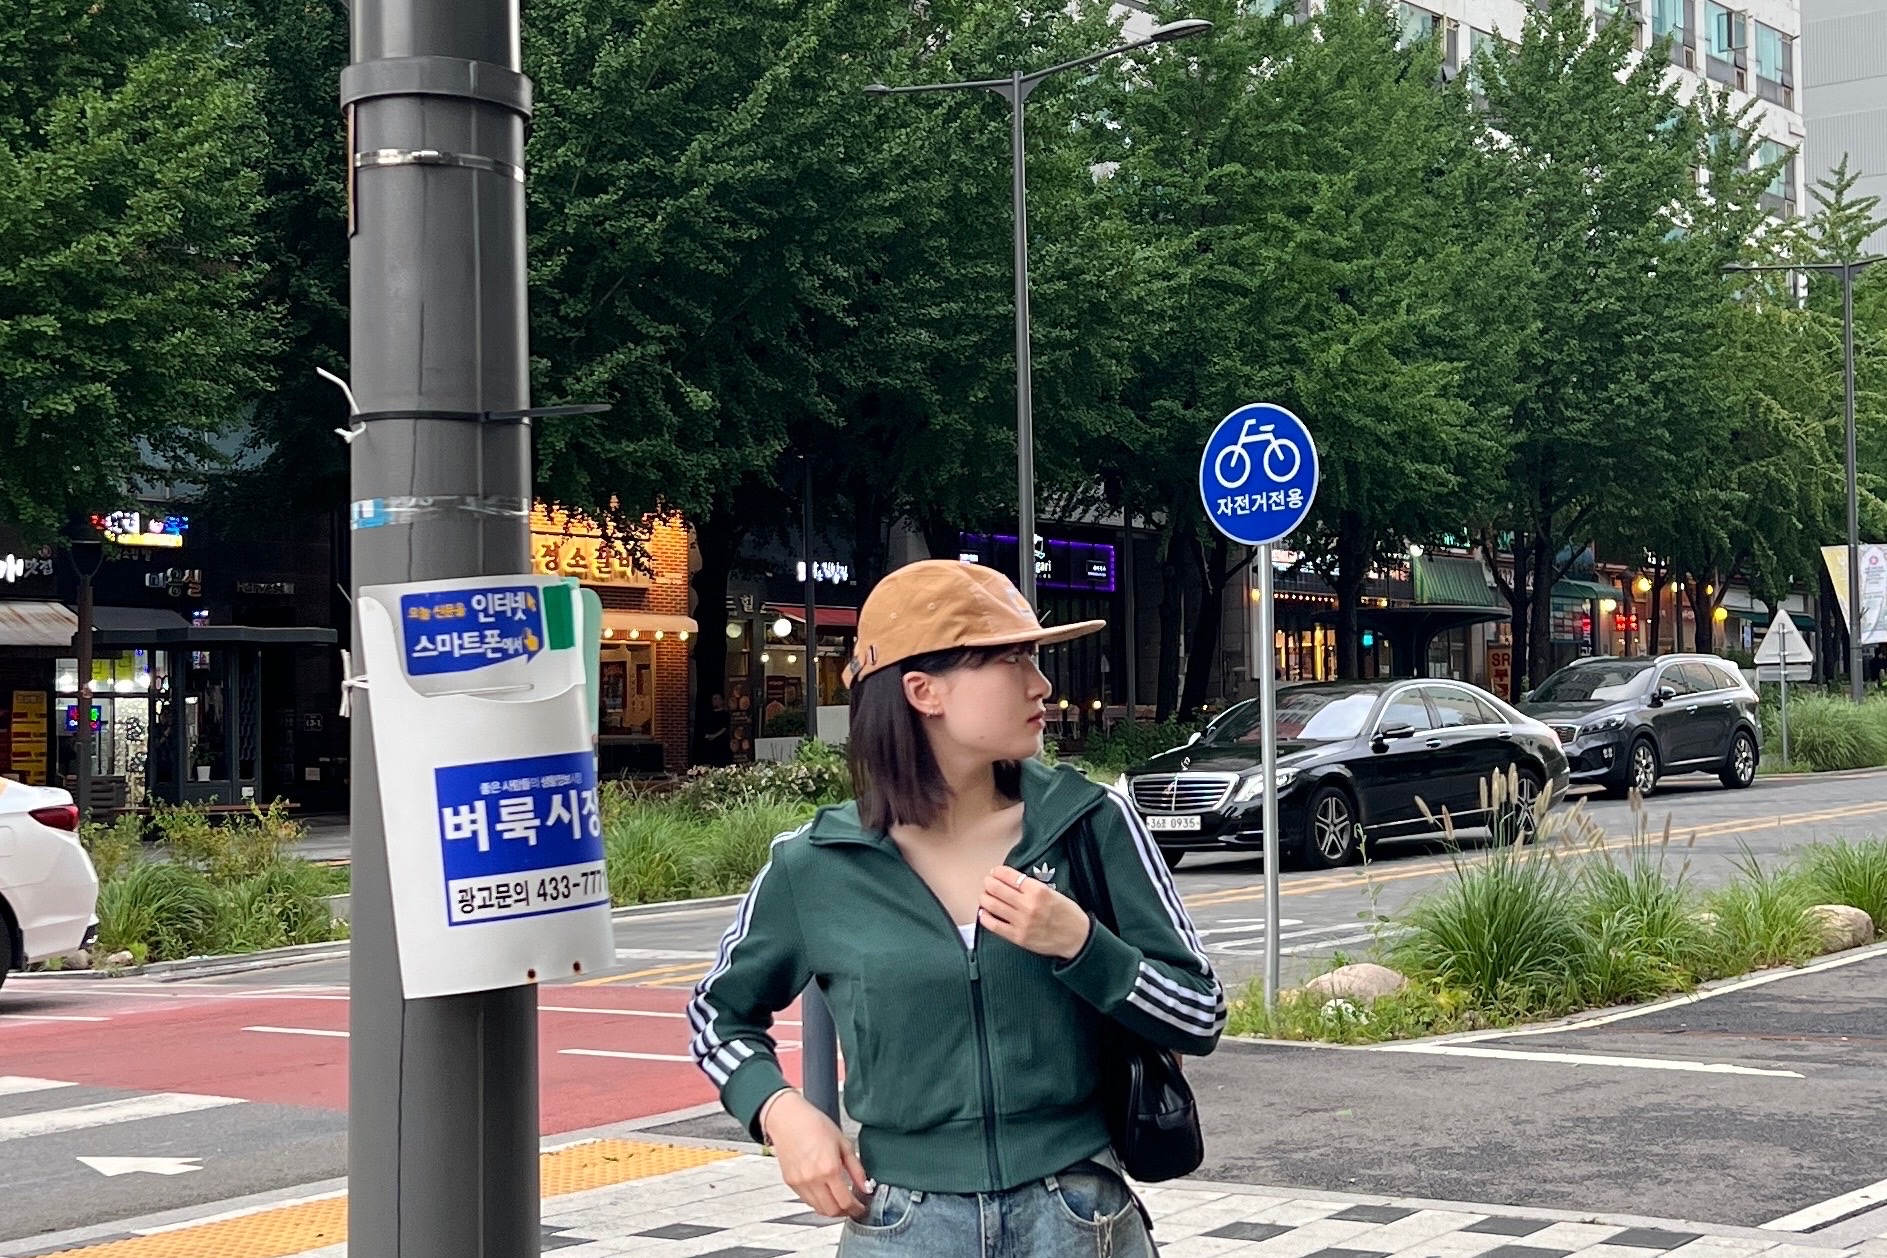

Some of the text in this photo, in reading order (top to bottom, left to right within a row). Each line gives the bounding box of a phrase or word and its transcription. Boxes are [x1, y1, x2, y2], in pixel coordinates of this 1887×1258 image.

[1216, 488, 1304, 516] 자전거전용
[145, 567, 202, 597] 미용실
[471, 591, 527, 623] 인터넷
[412, 629, 524, 659] 스마트폰에서
[441, 788, 601, 853] 벼룩시장
[458, 880, 530, 914] 광고문의
